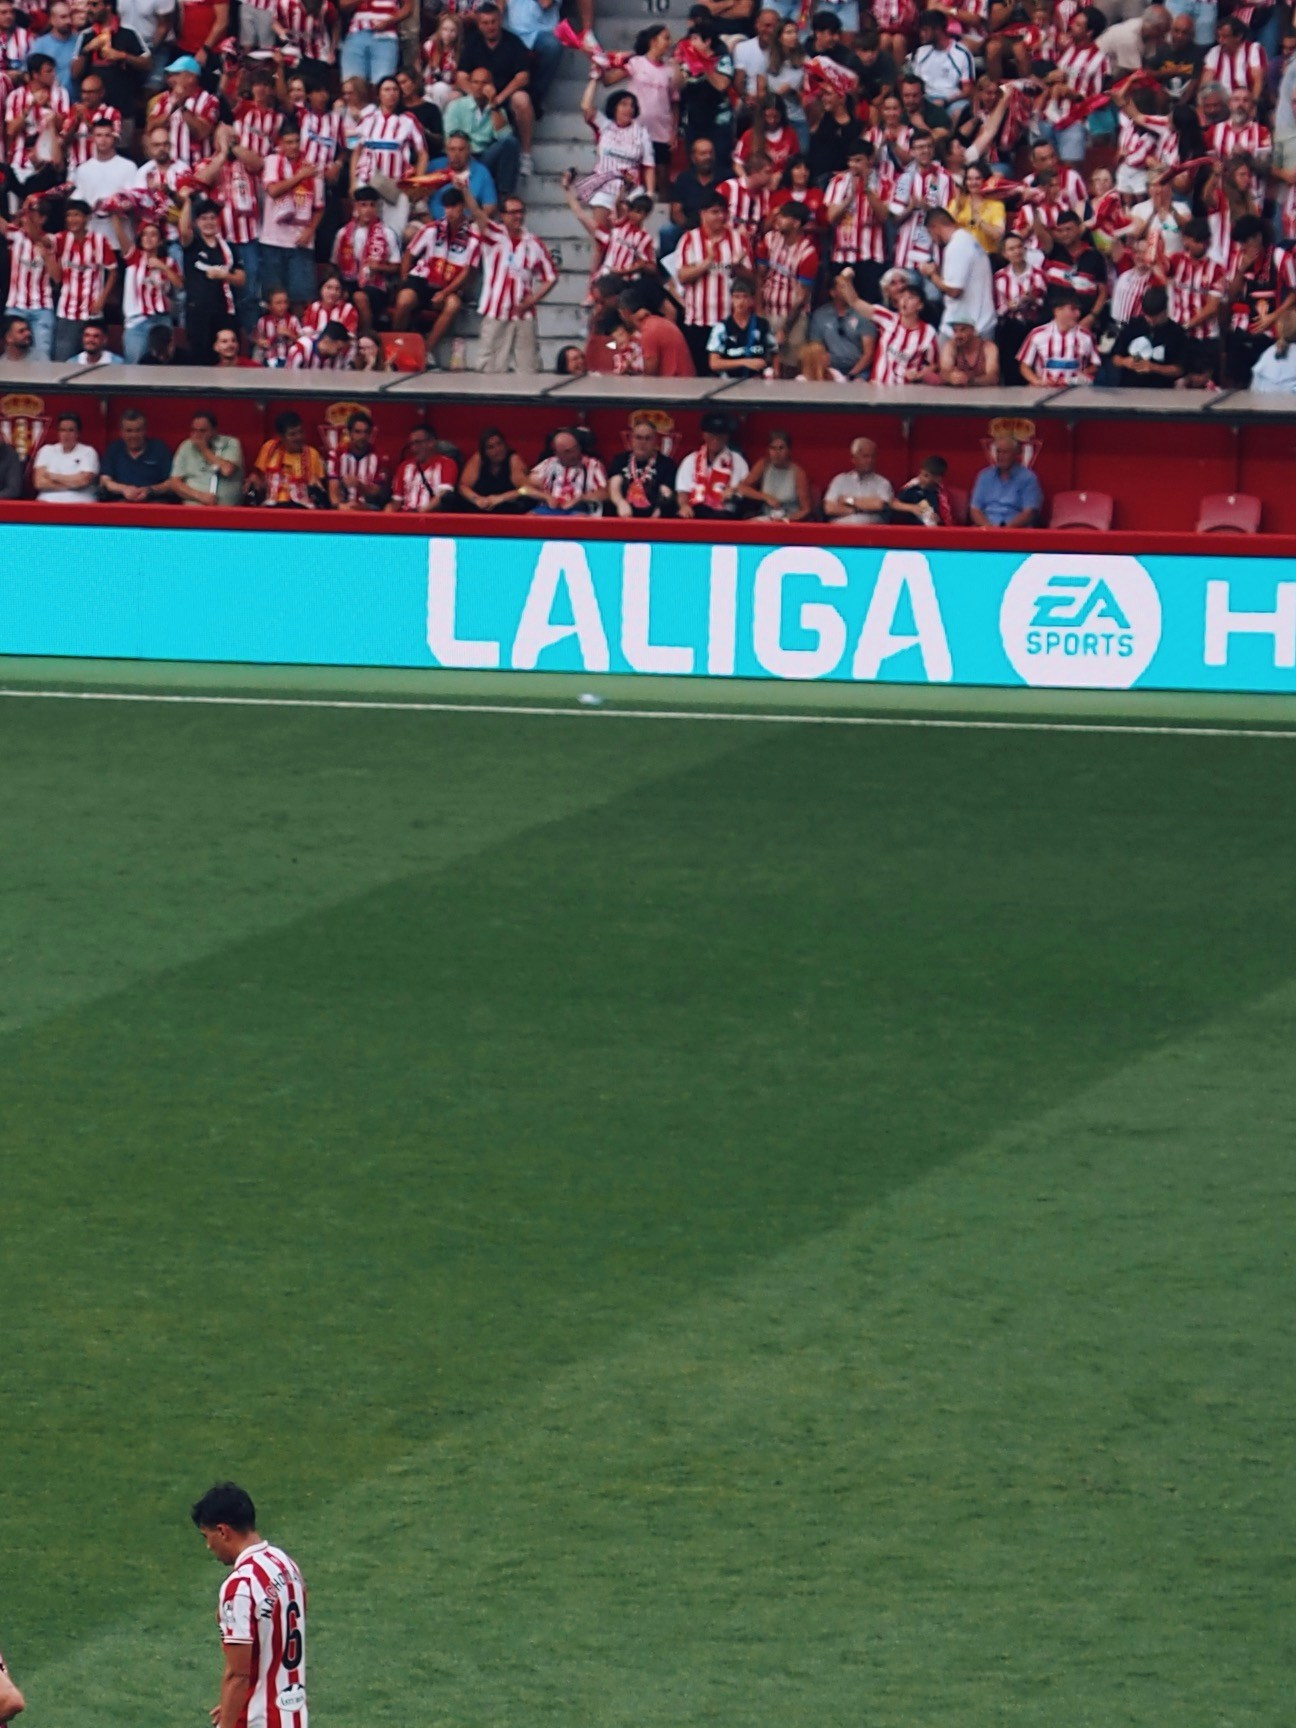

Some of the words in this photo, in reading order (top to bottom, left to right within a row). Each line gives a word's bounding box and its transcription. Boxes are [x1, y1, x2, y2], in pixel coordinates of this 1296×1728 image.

[426, 538, 953, 683] LALIGA
[1028, 576, 1130, 629] EA
[1026, 630, 1134, 658] SPORTS
[281, 1600, 303, 1671] 6
